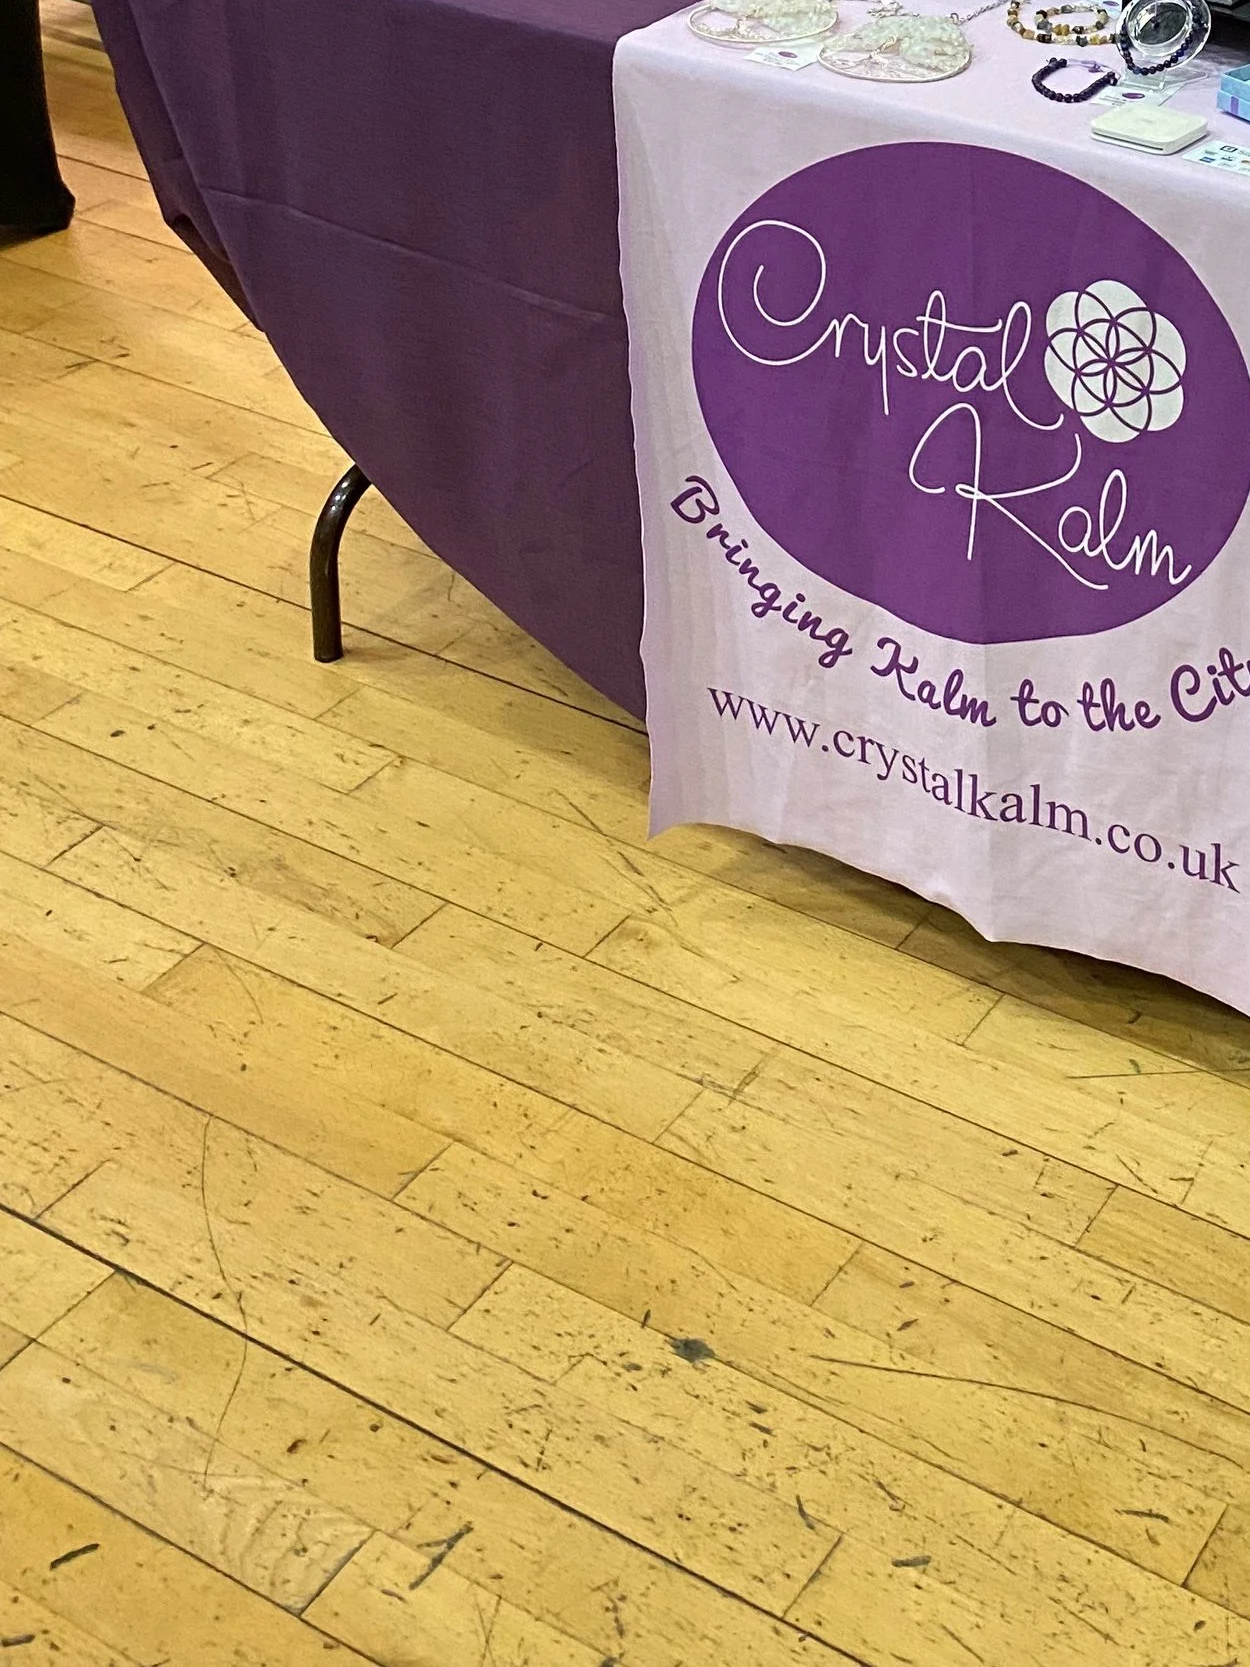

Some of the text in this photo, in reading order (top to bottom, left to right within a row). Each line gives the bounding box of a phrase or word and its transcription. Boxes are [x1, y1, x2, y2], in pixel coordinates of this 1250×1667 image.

[718, 219, 1064, 431] Crystal
[908, 402, 1192, 590] Kalm
[670, 475, 853, 669] Bringing
[870, 636, 997, 728] Kalm
[1010, 678, 1069, 728] to
[1077, 677, 1161, 732] the
[706, 684, 1241, 894] www.crystalkalm.co.uk
